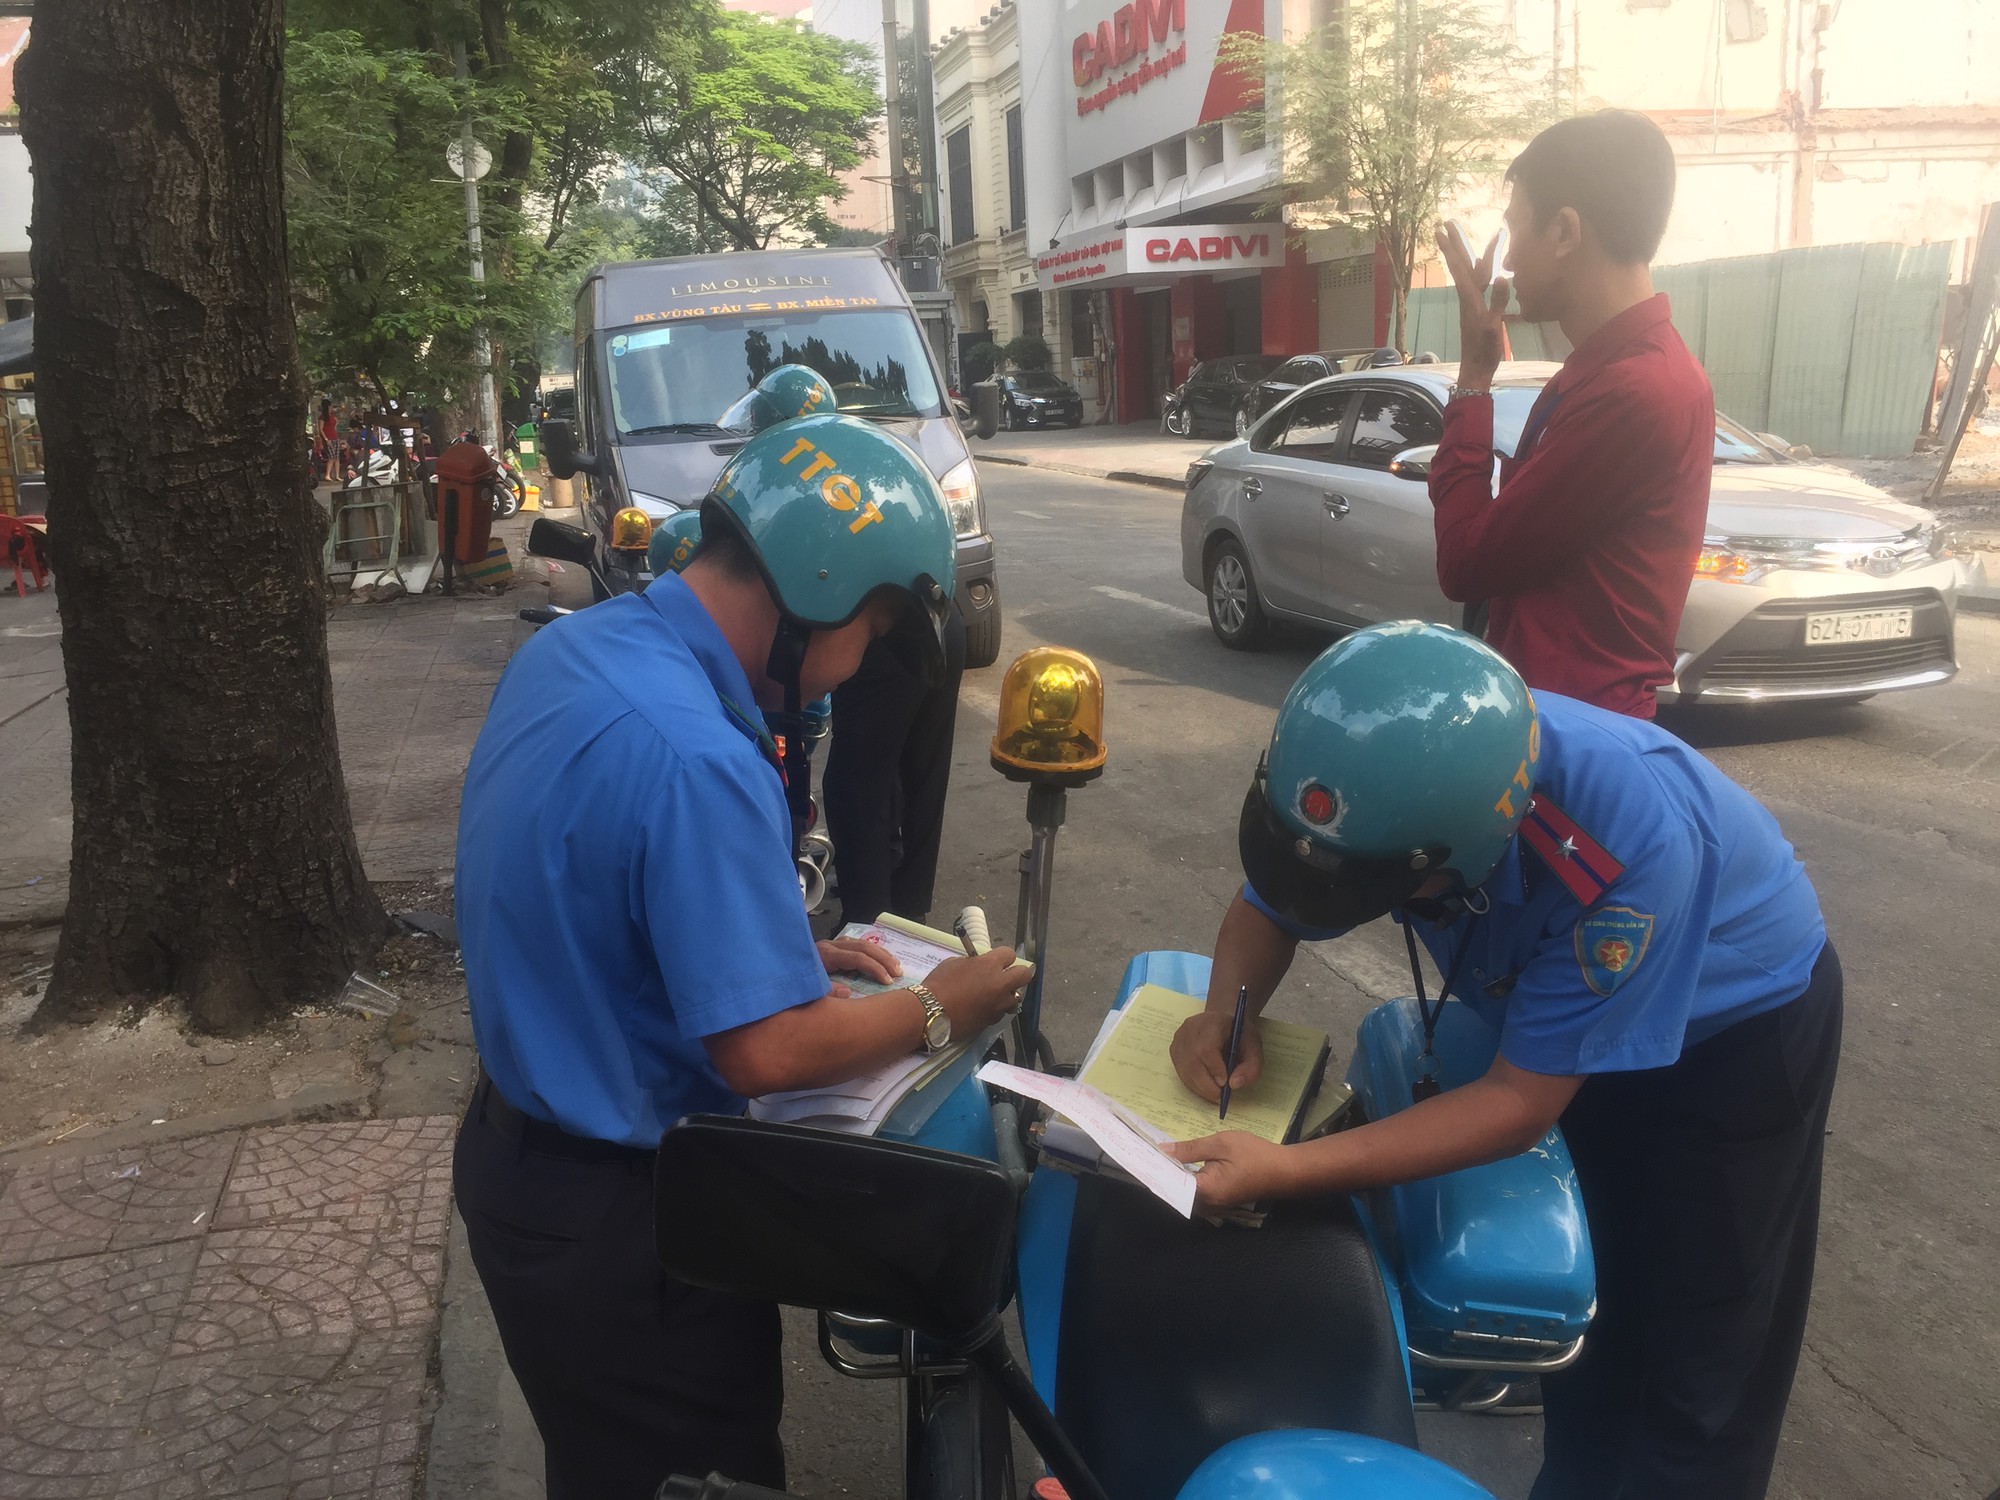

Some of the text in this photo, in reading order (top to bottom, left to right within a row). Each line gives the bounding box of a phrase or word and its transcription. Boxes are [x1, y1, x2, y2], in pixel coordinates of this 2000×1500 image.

[1073, 0, 1185, 88] CADIVI
[1146, 234, 1269, 263] CADIVI
[671, 276, 832, 296] LIMOUSINE
[710, 303, 742, 315] TÀU
[779, 437, 884, 535] TTGT
